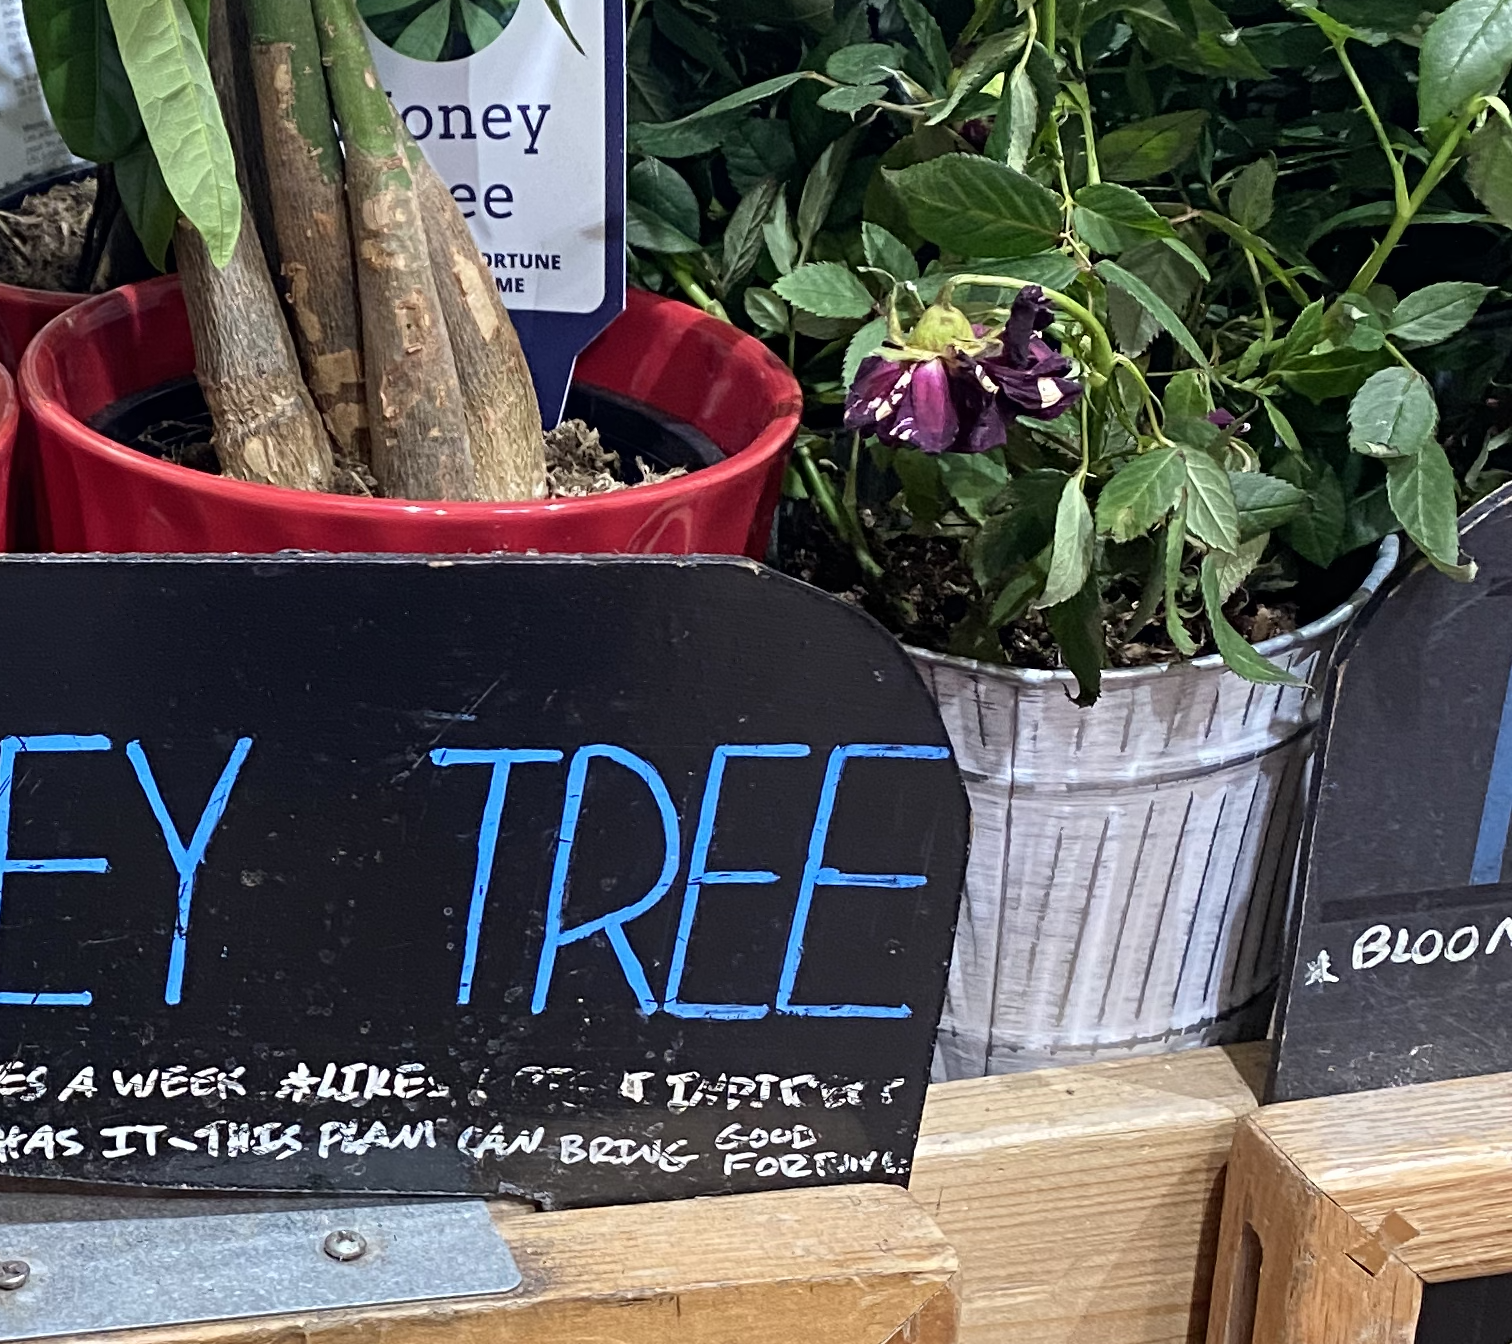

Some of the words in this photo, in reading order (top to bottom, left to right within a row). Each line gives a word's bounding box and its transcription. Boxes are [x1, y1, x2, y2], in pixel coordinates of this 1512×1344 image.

[399, 103, 551, 155] oney
[450, 184, 514, 219] ee
[481, 252, 561, 270] ORTUNE
[495, 277, 525, 293] ME
[429, 743, 951, 1021] TREE
[57, 1065, 99, 1103] A
[112, 1064, 247, 1101] WEEK
[456, 1122, 546, 1161] CAN
[559, 1134, 700, 1173] BRING
[715, 1123, 818, 1151] GOOD
